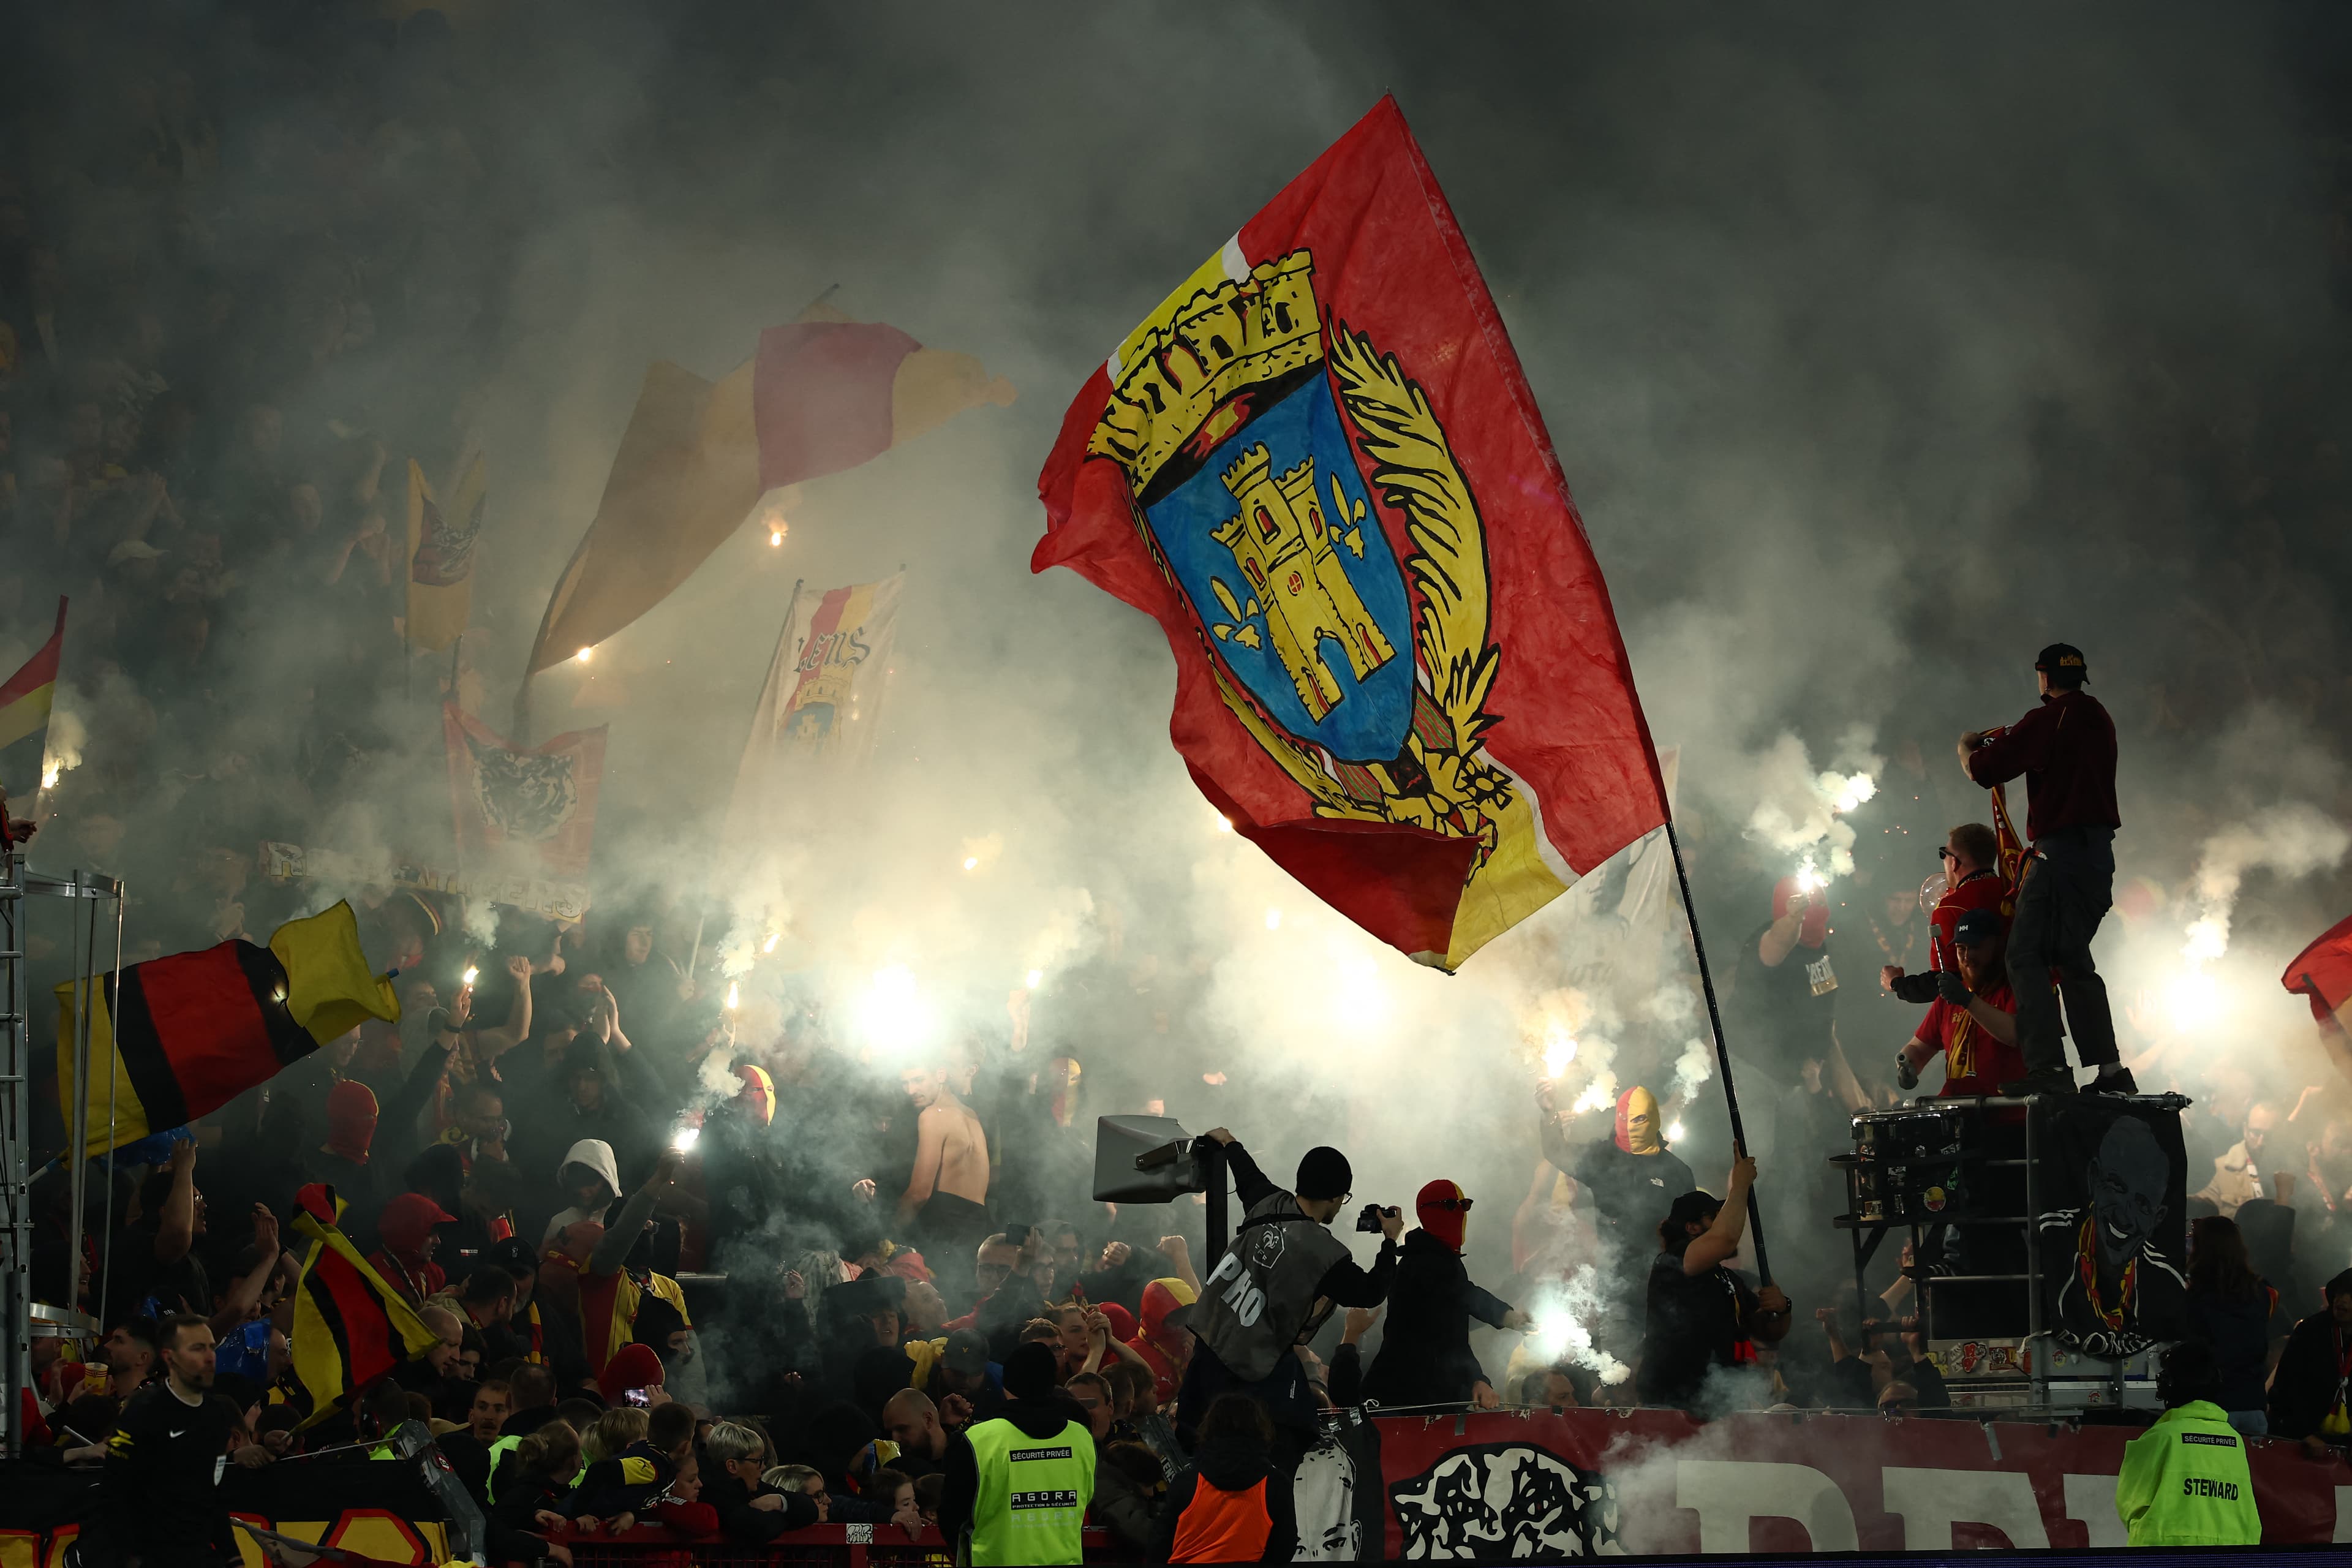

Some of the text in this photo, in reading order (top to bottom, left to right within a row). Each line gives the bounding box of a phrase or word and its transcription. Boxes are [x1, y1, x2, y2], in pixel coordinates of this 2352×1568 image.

[2184, 1435, 2215, 1444] SÉCURITÉ
[1012, 1449, 1070, 1460] SÉCURITÉ PRIVÉE
[2184, 1478, 2239, 1501] STEWARD
[1012, 1491, 1076, 1502] AGORA
